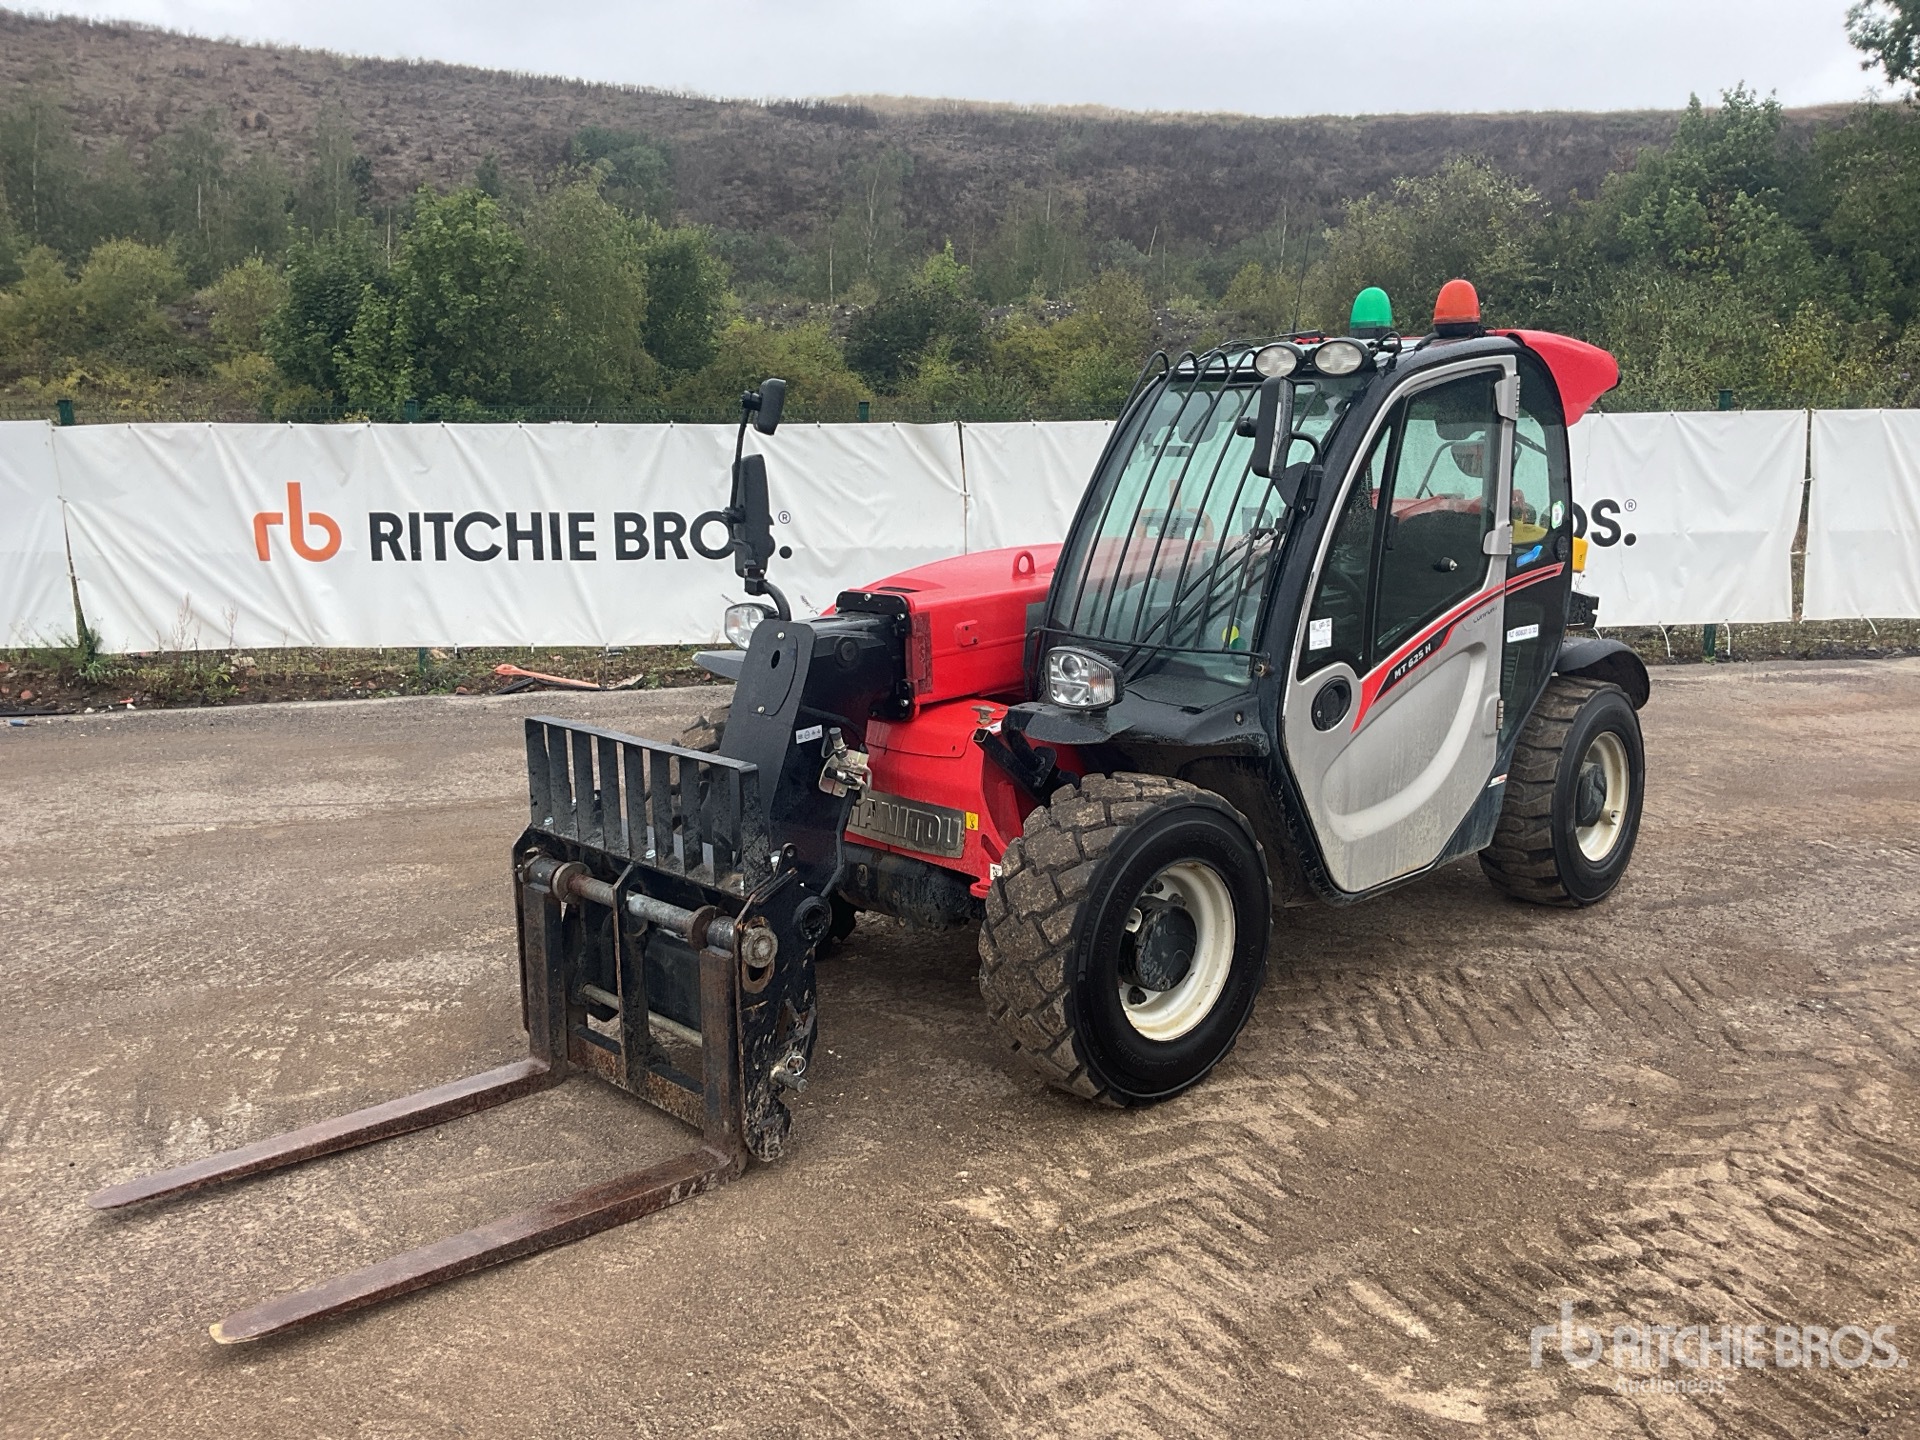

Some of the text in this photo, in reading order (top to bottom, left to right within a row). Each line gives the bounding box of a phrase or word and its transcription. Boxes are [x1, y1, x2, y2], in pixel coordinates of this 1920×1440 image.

[368, 510, 793, 561] RITCHIE BRO.
[1393, 664, 1408, 680] MT
[1408, 649, 1425, 668] 625
